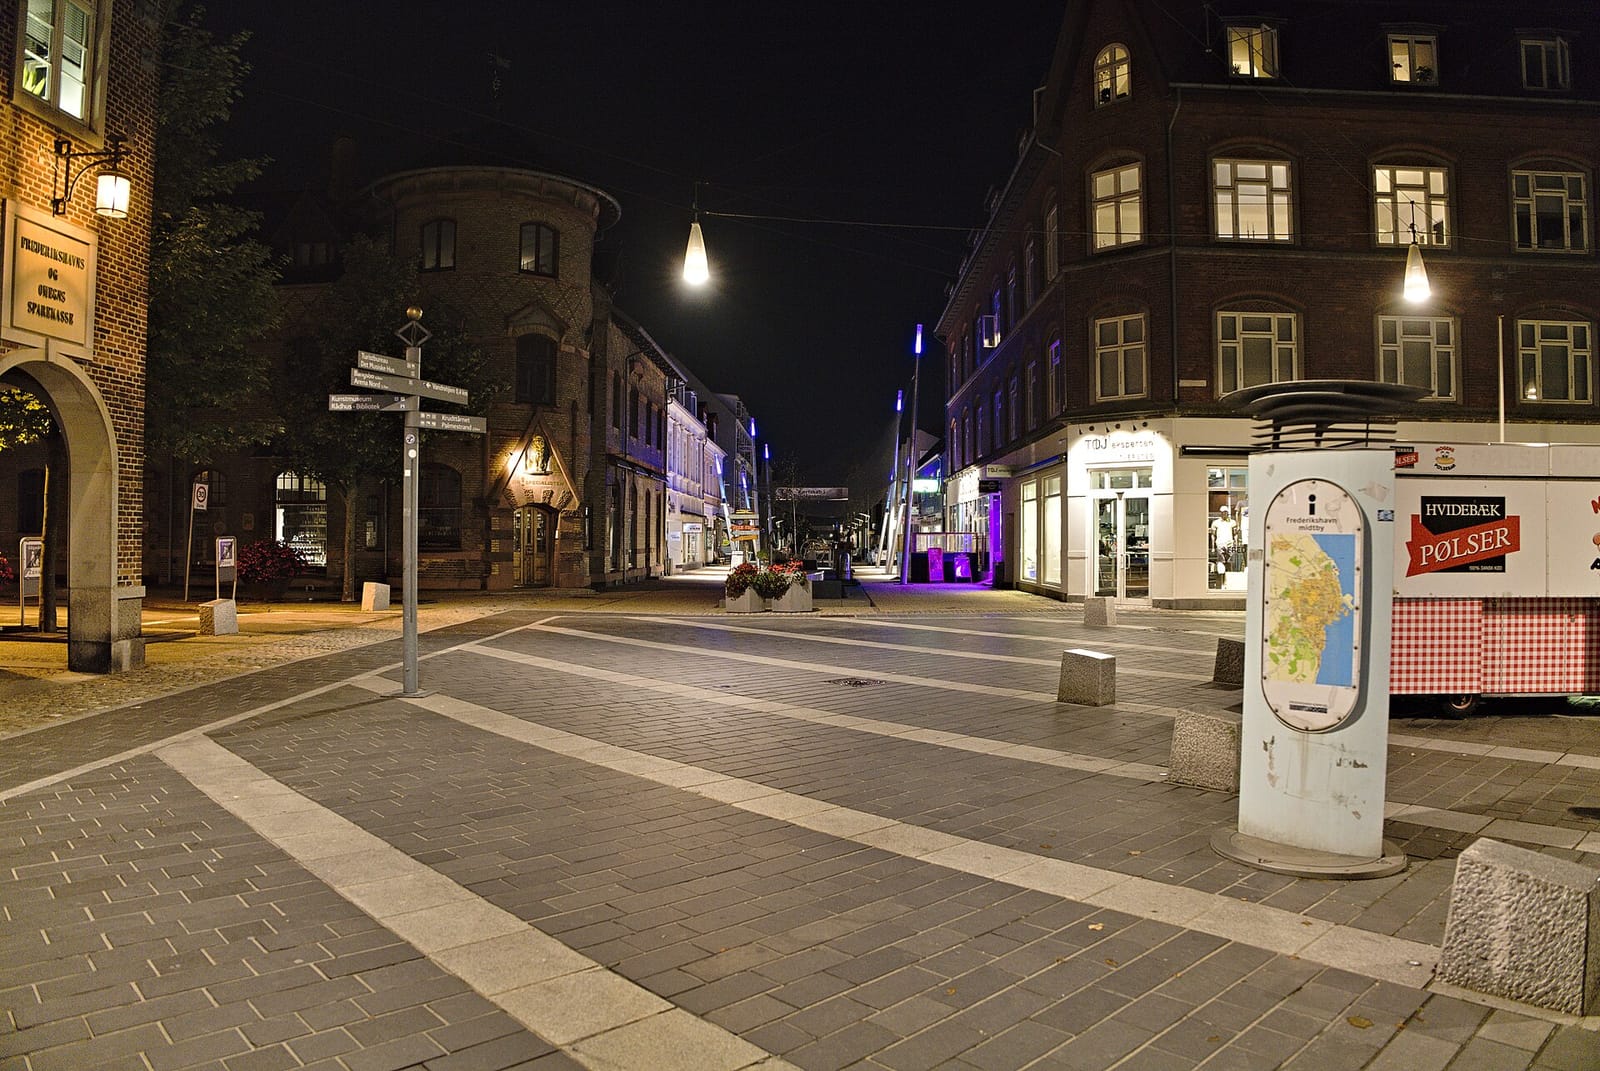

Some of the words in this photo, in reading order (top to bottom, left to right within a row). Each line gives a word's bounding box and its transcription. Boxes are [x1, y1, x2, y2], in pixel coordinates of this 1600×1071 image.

[20, 236, 85, 270] FREDERIKSHAVNS
[47, 267, 58, 281] OG
[27, 301, 74, 326] SPAREKASSE
[198, 490, 205, 498] 30
[1425, 503, 1502, 517] HVIDEBÆK
[1286, 517, 1338, 525] Frederikshavn
[1419, 527, 1511, 567] PØLSER
